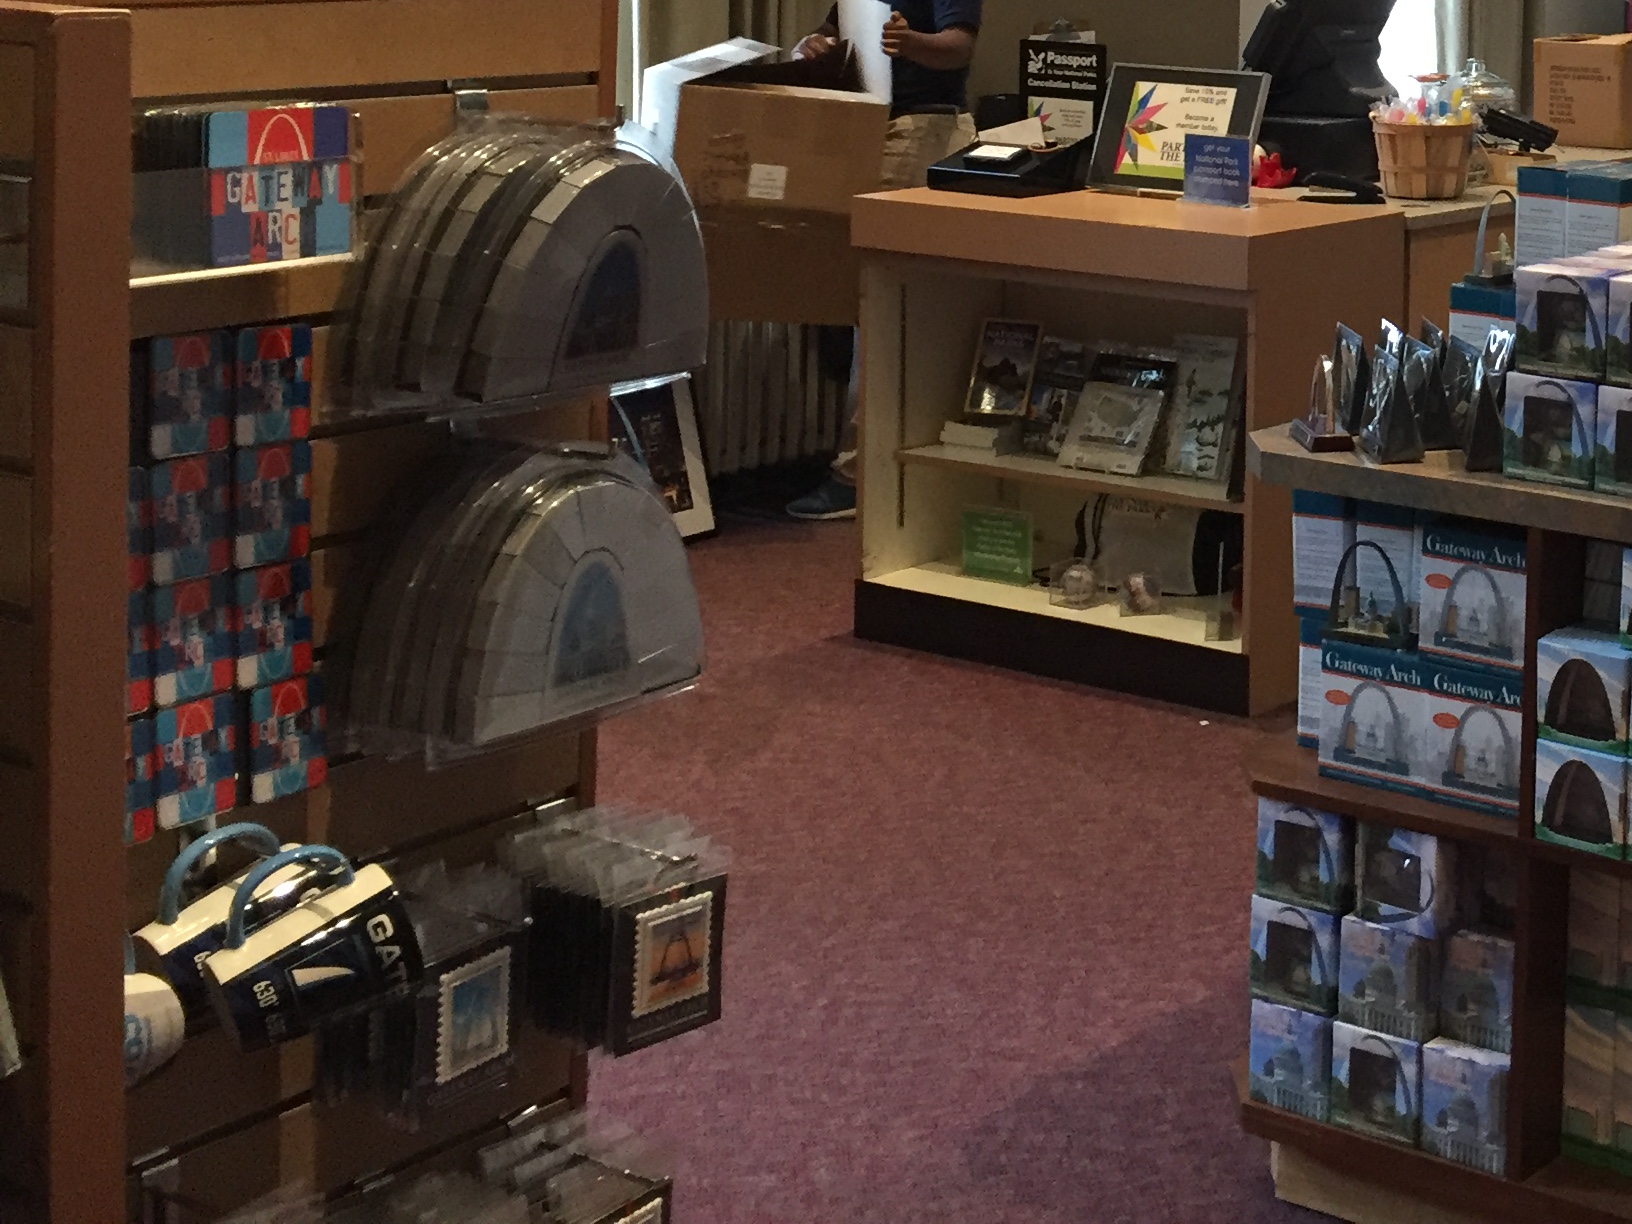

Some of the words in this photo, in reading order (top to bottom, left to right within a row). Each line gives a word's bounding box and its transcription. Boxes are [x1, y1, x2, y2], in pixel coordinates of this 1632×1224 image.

[1046, 51, 1097, 68] Passport
[1184, 113, 1209, 122] Become
[1175, 122, 1200, 130] member
[1160, 151, 1181, 162] THE
[1195, 154, 1223, 165] National
[1224, 156, 1239, 166] Park
[1223, 167, 1240, 176] book
[226, 163, 339, 207] GATEWAY
[1426, 533, 1486, 565] Gateway
[1325, 651, 1382, 681] Gateway
[1385, 664, 1421, 686] Arch
[1433, 672, 1494, 704] Gateway
